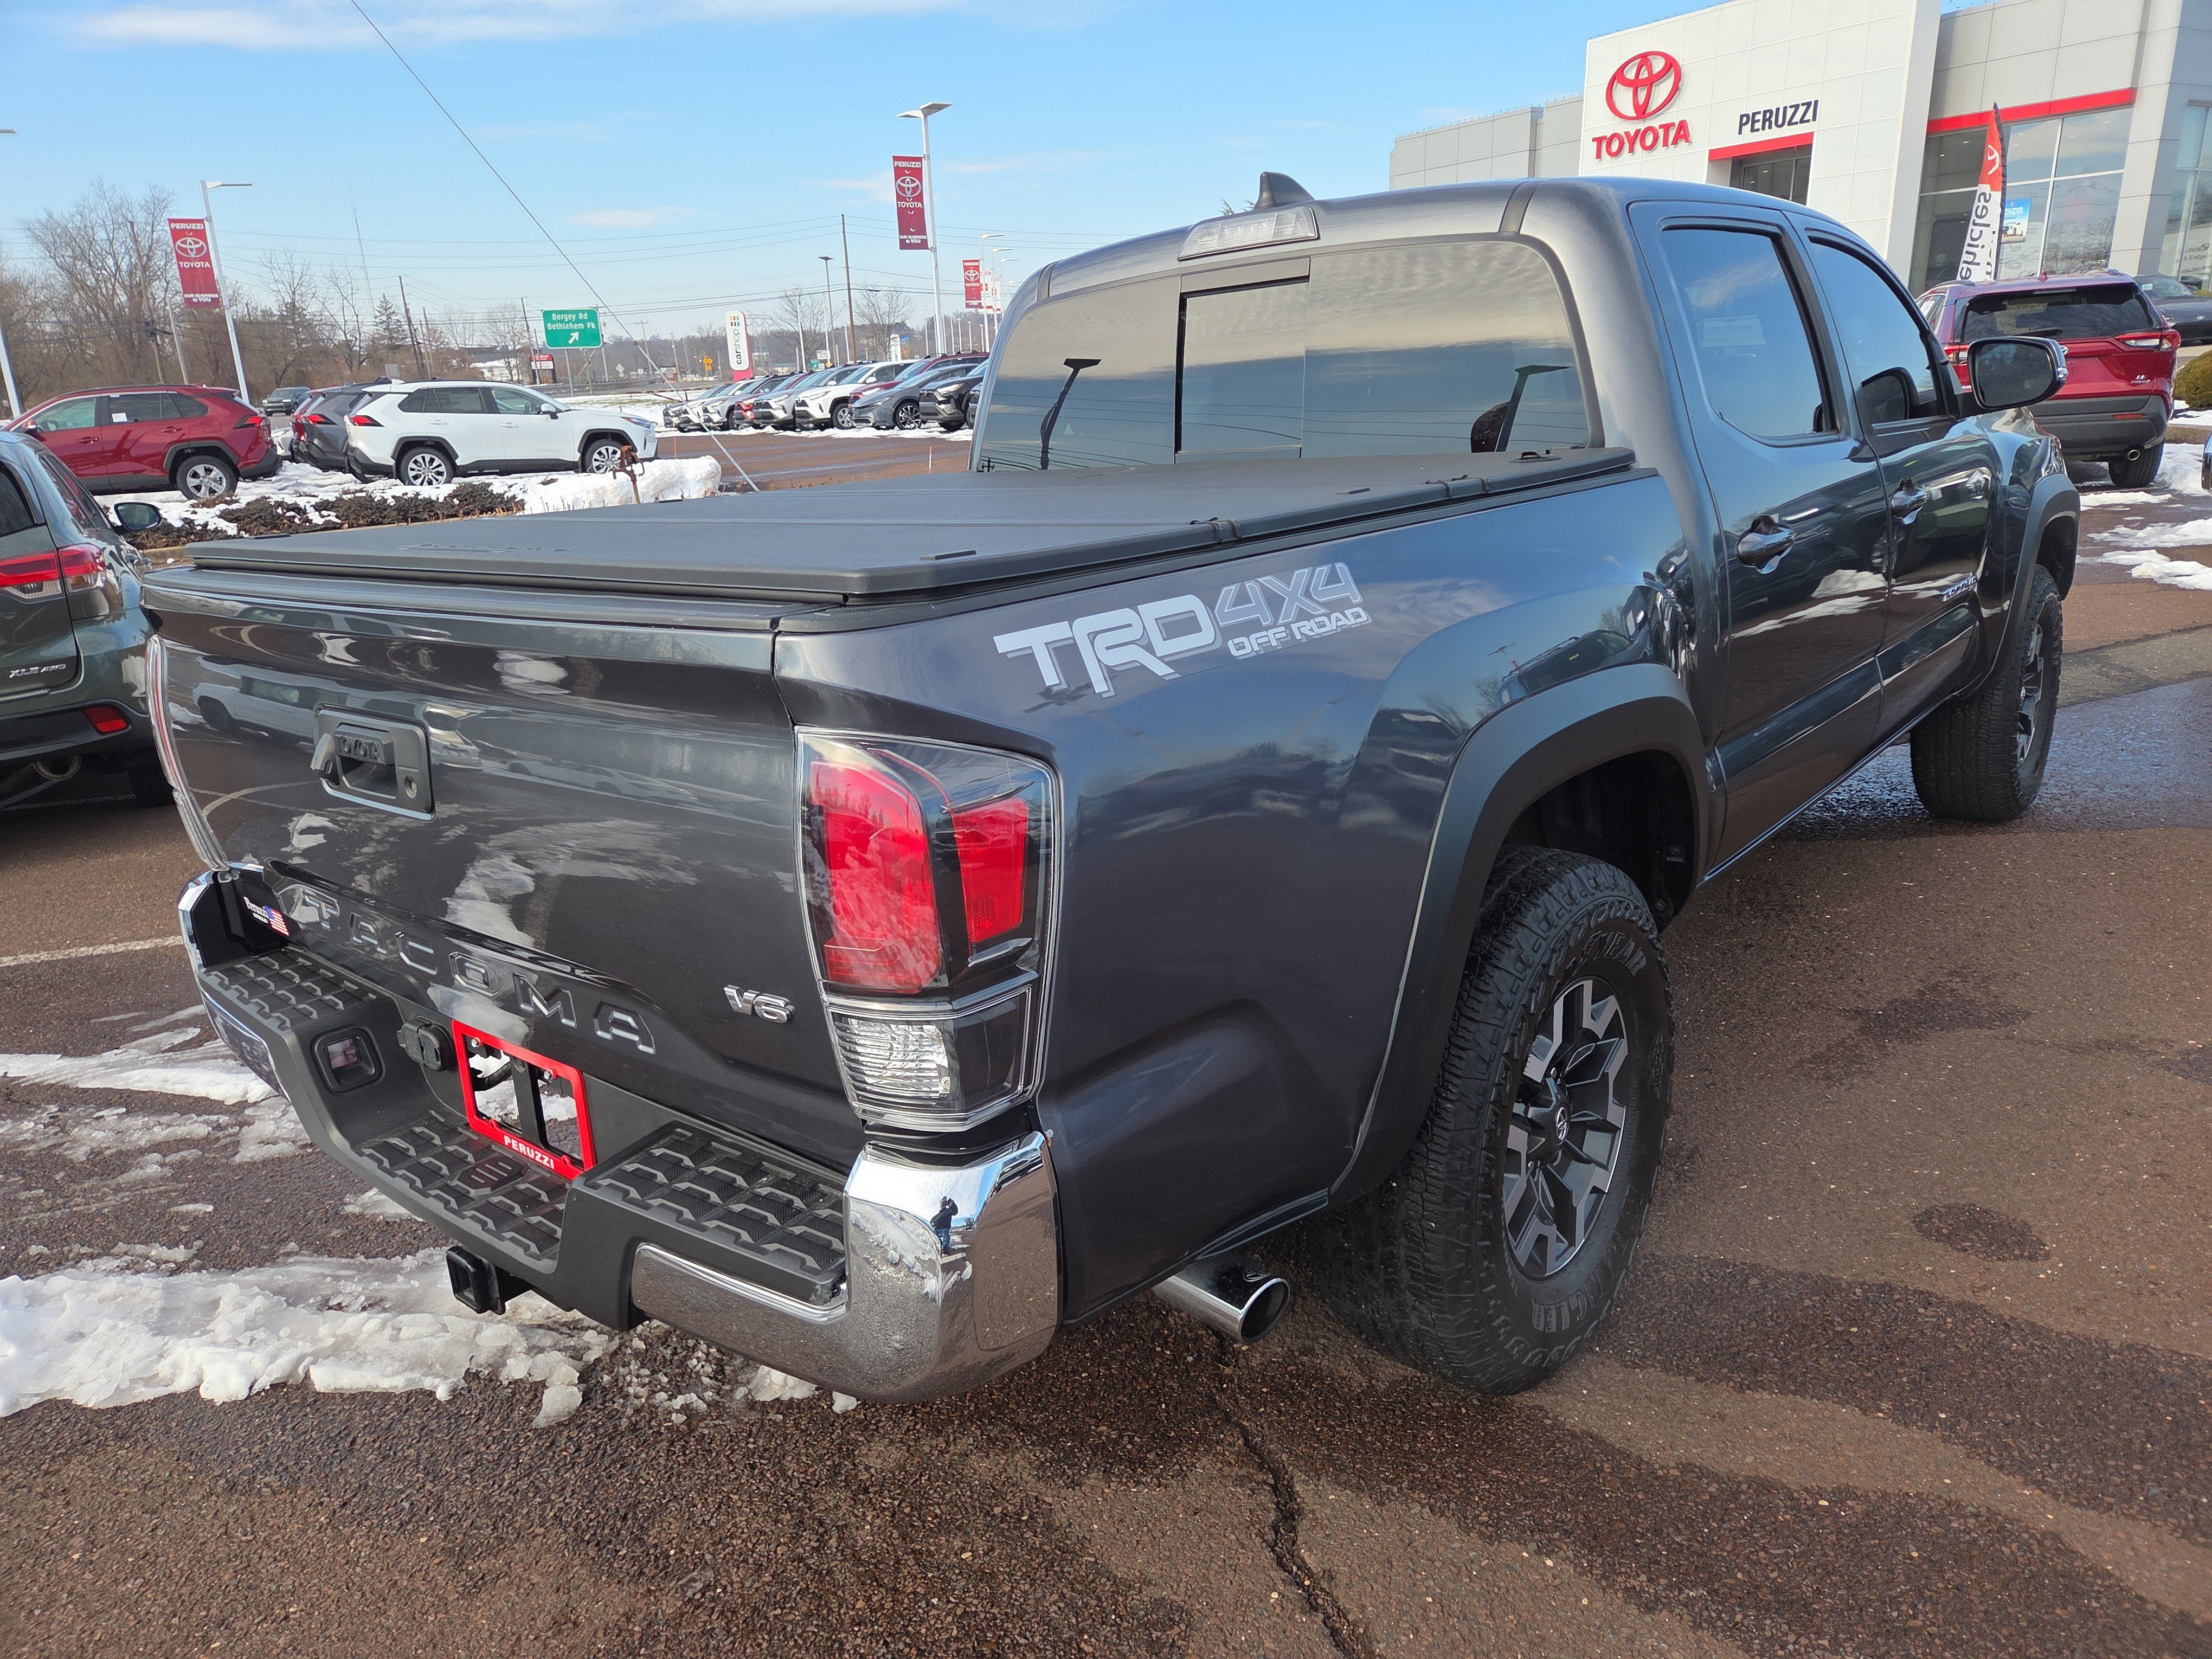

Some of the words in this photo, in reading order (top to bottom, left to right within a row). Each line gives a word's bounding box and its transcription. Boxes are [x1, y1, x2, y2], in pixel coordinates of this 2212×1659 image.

[1738, 99, 1819, 135] PERUZZI
[1592, 119, 1692, 159] TOYOTA
[552, 313, 576, 321] Bergey
[733, 329, 742, 365] carshop
[993, 594, 1220, 698] TRD
[1227, 625, 1291, 659] OFF
[1293, 607, 1371, 641] ROAD
[335, 734, 386, 764] TOYOTA
[303, 888, 656, 1054] TACOMA
[723, 984, 795, 1023] V6
[504, 1135, 554, 1169] PERUZZI
